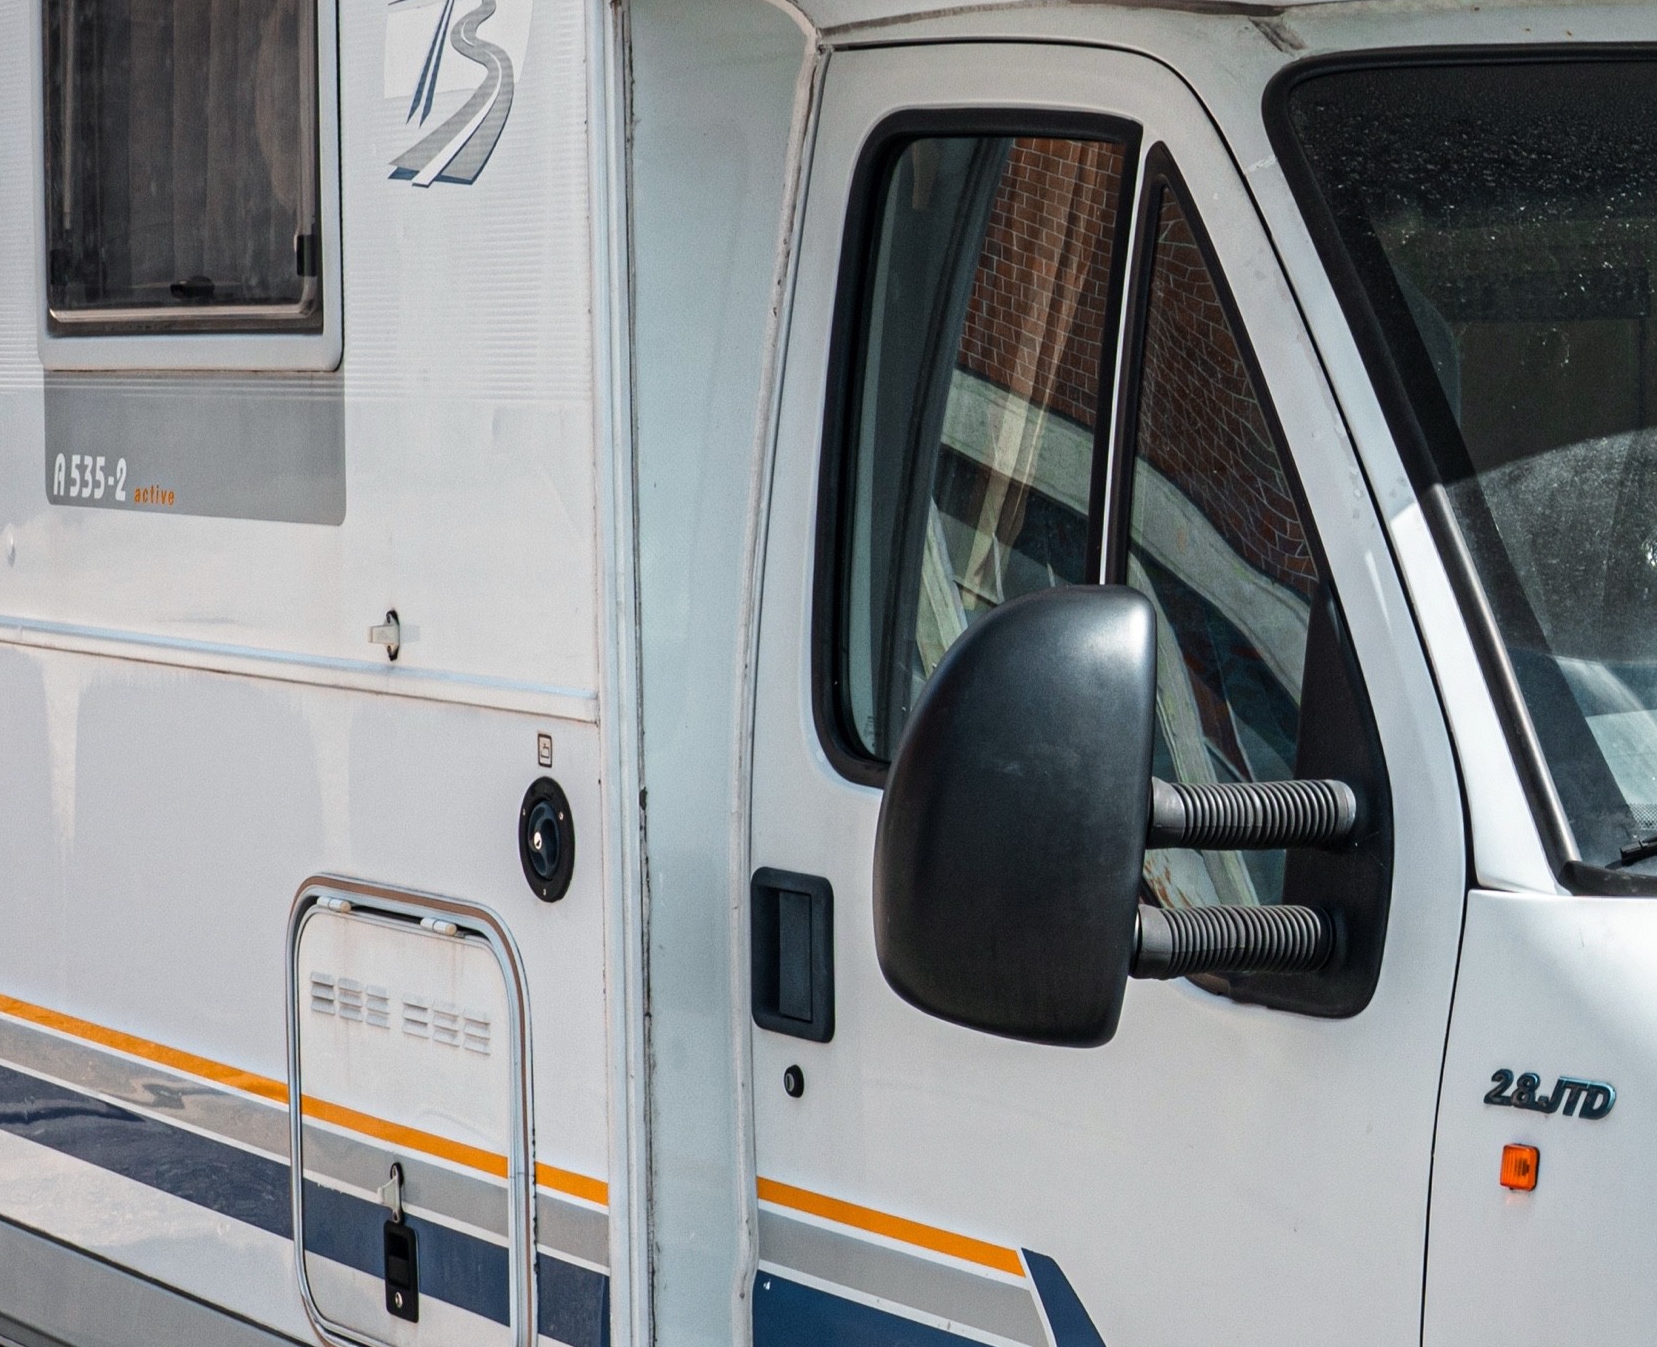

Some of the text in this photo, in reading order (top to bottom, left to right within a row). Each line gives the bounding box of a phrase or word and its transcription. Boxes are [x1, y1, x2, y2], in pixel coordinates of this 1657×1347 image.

[53, 452, 175, 508] A 535-2 active
